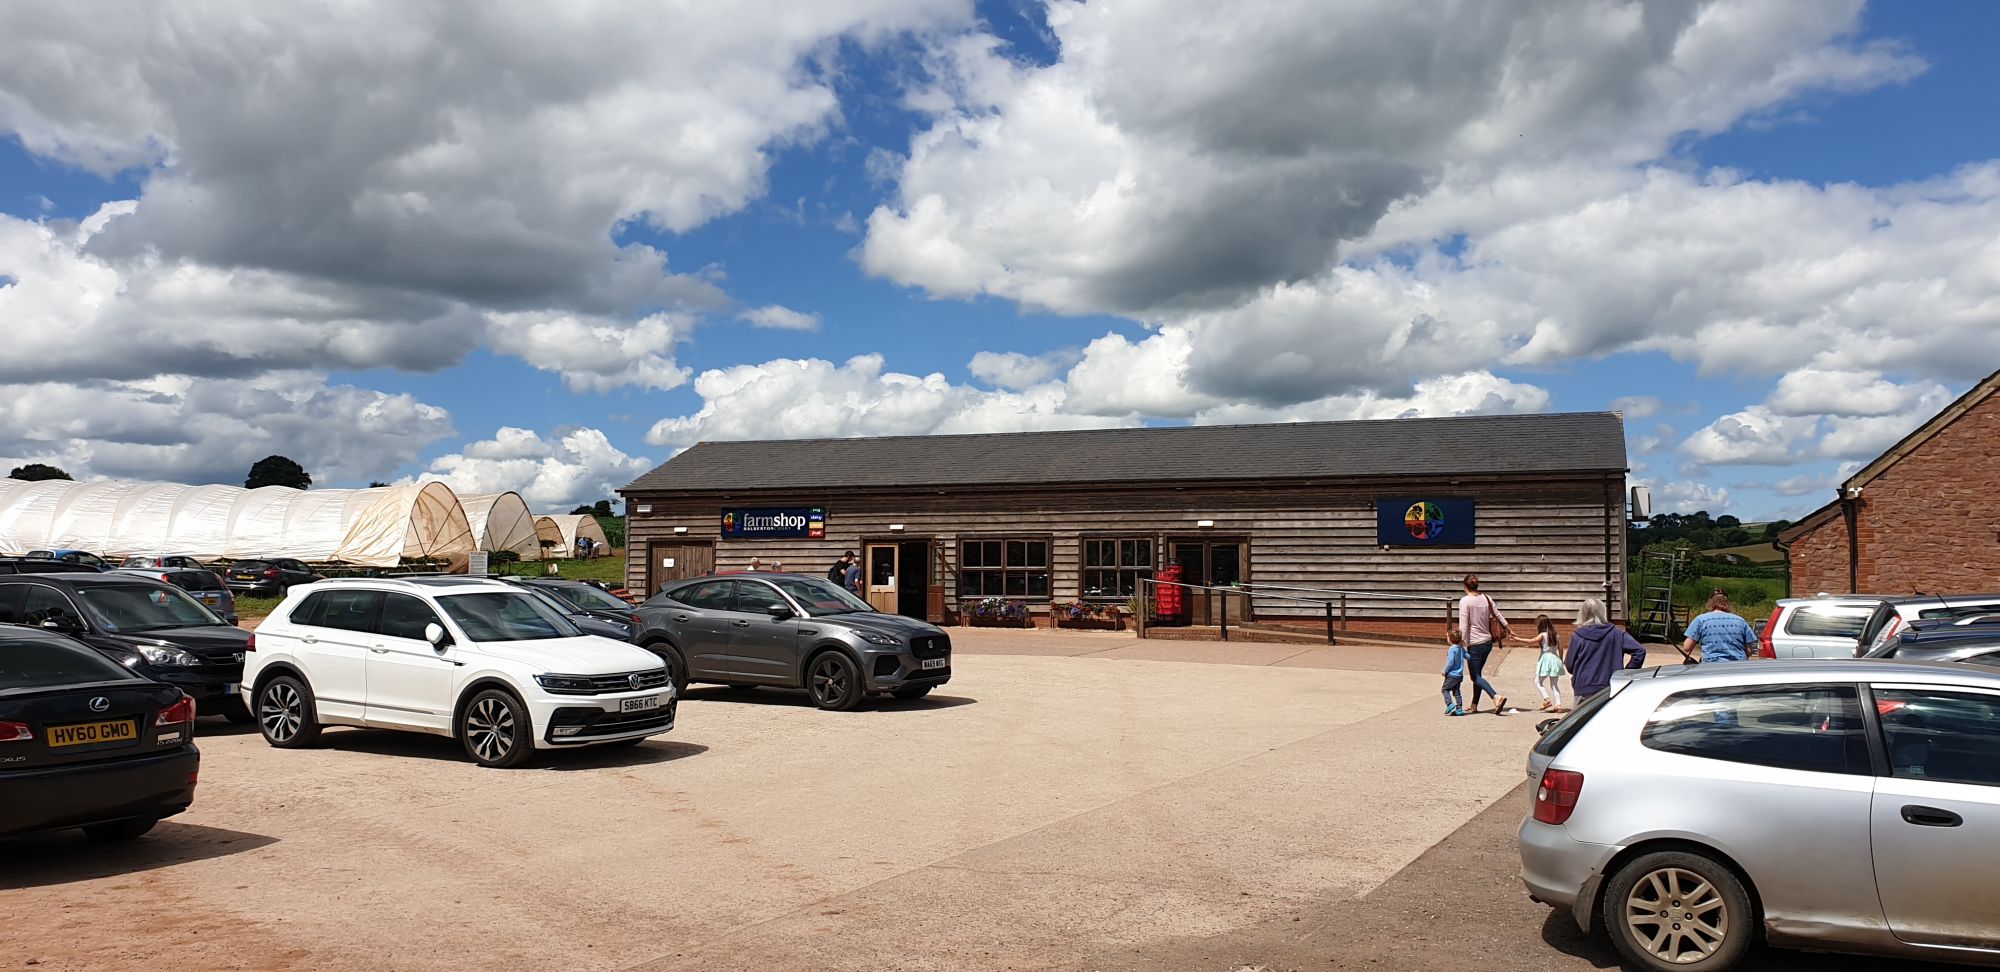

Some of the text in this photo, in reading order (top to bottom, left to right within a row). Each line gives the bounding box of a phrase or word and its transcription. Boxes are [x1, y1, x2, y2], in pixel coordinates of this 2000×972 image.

[743, 512, 806, 530] farmshop
[624, 697, 658, 711] SB66 KTC
[54, 722, 130, 744] HV60 GMO
